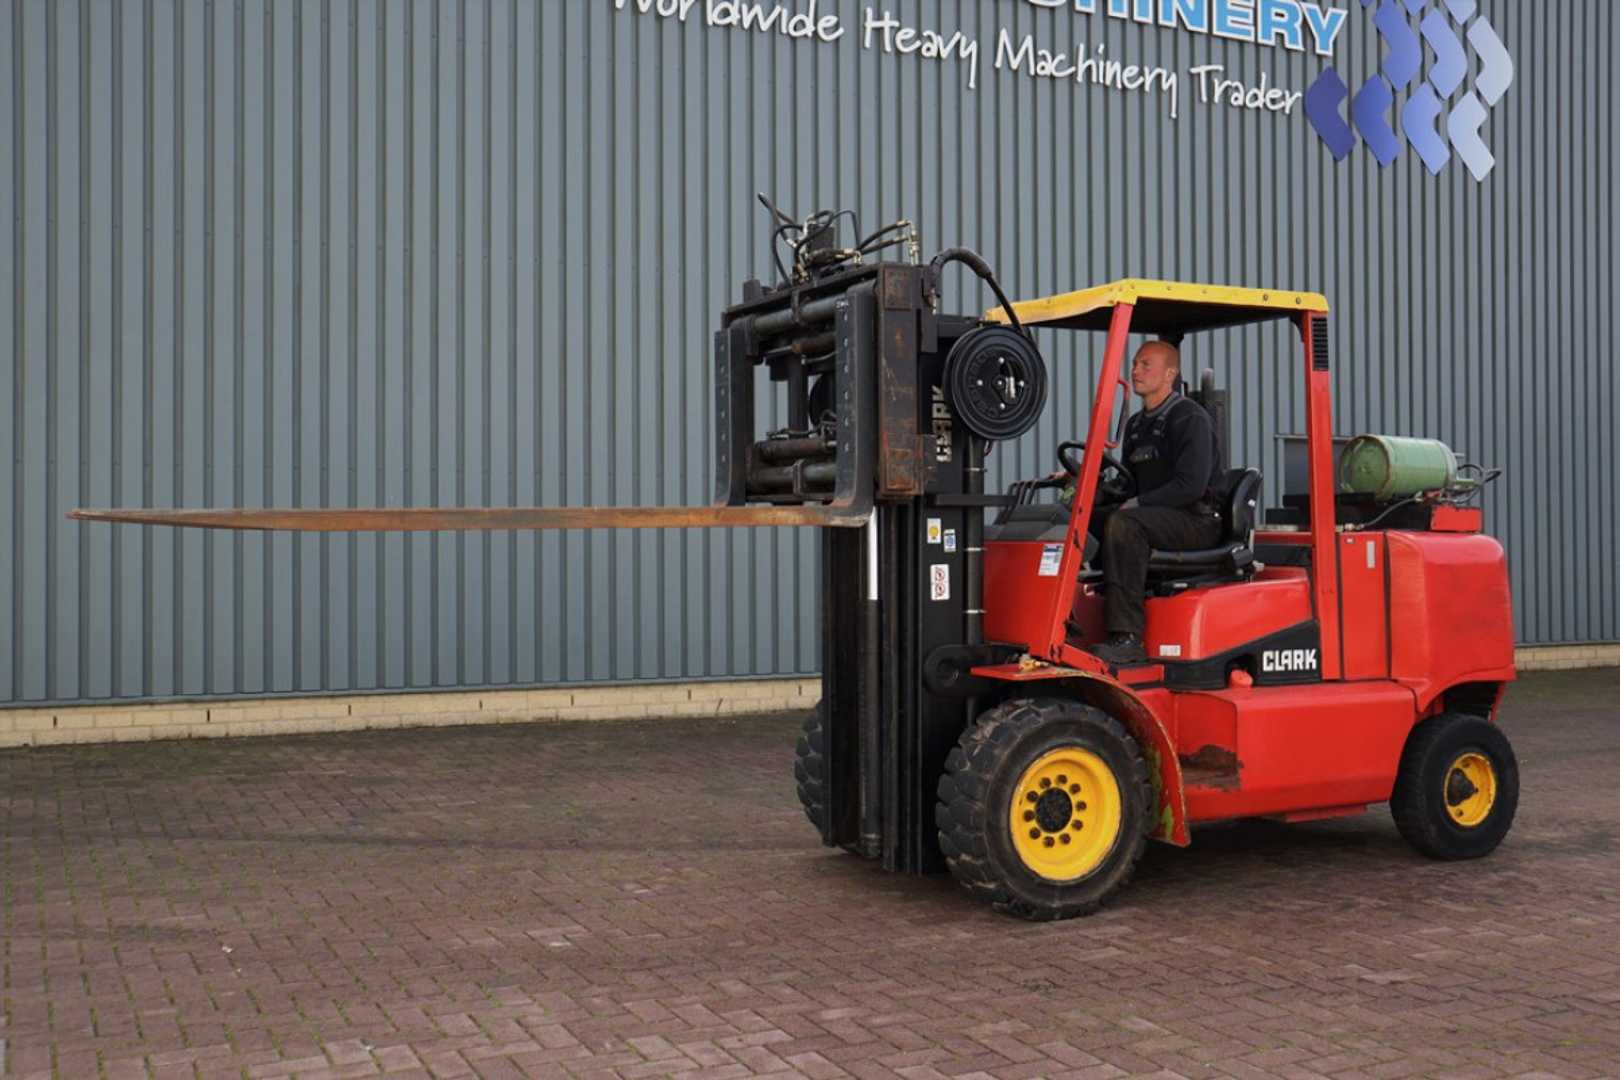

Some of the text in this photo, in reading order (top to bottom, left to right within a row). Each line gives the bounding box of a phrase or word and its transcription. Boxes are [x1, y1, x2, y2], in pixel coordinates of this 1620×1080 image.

[1028, 0, 1349, 57] NERY
[614, 0, 1303, 119] orldwide Heavy Machinery Trader
[1261, 648, 1318, 672] CLARK
